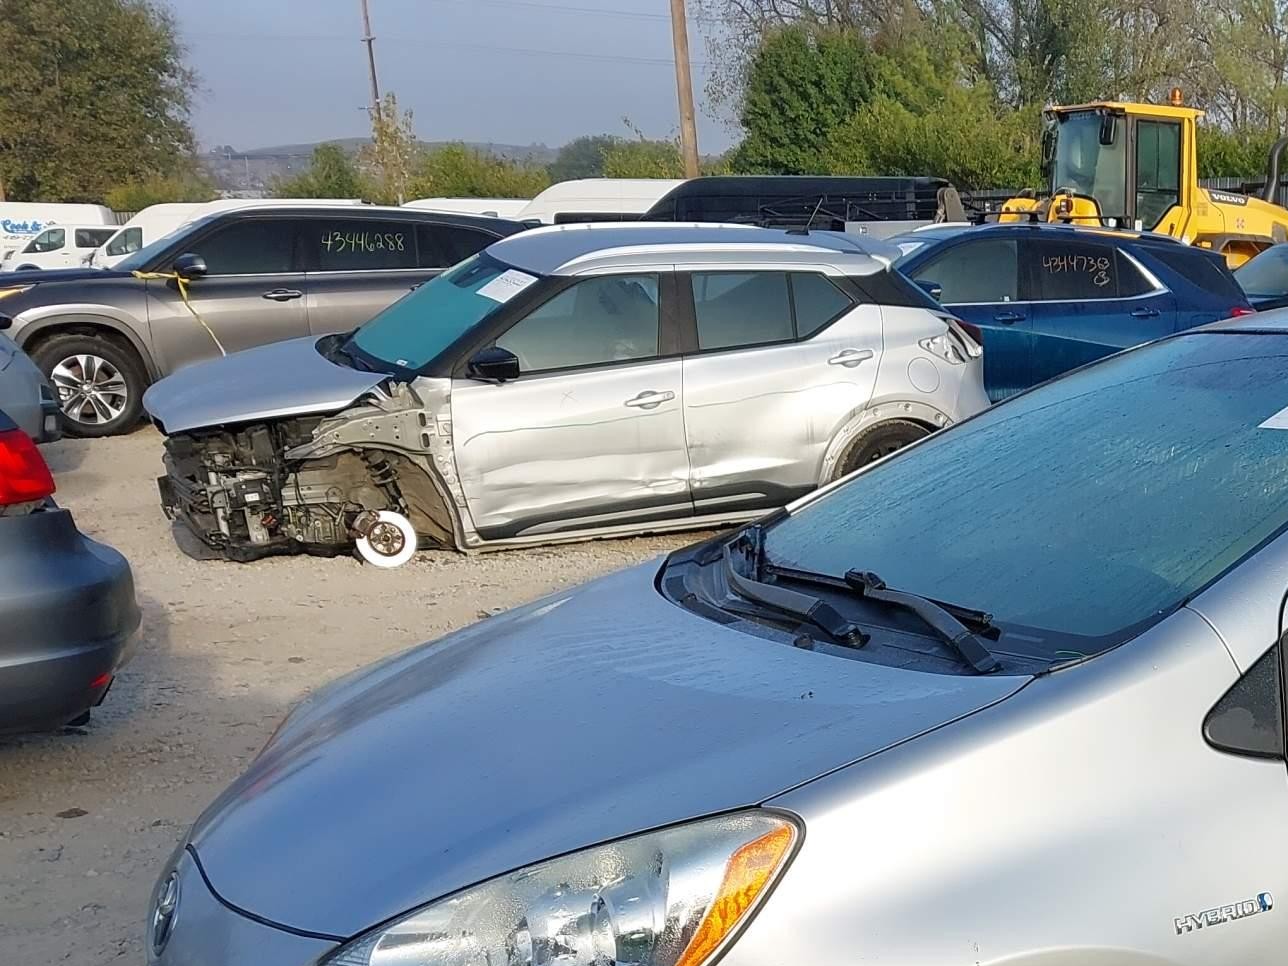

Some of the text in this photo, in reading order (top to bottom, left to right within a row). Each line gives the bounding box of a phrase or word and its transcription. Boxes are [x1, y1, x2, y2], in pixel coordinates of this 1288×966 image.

[1211, 193, 1246, 204] VOLVO
[321, 231, 405, 252] 43446288
[1174, 899, 1260, 935] HYBRID
